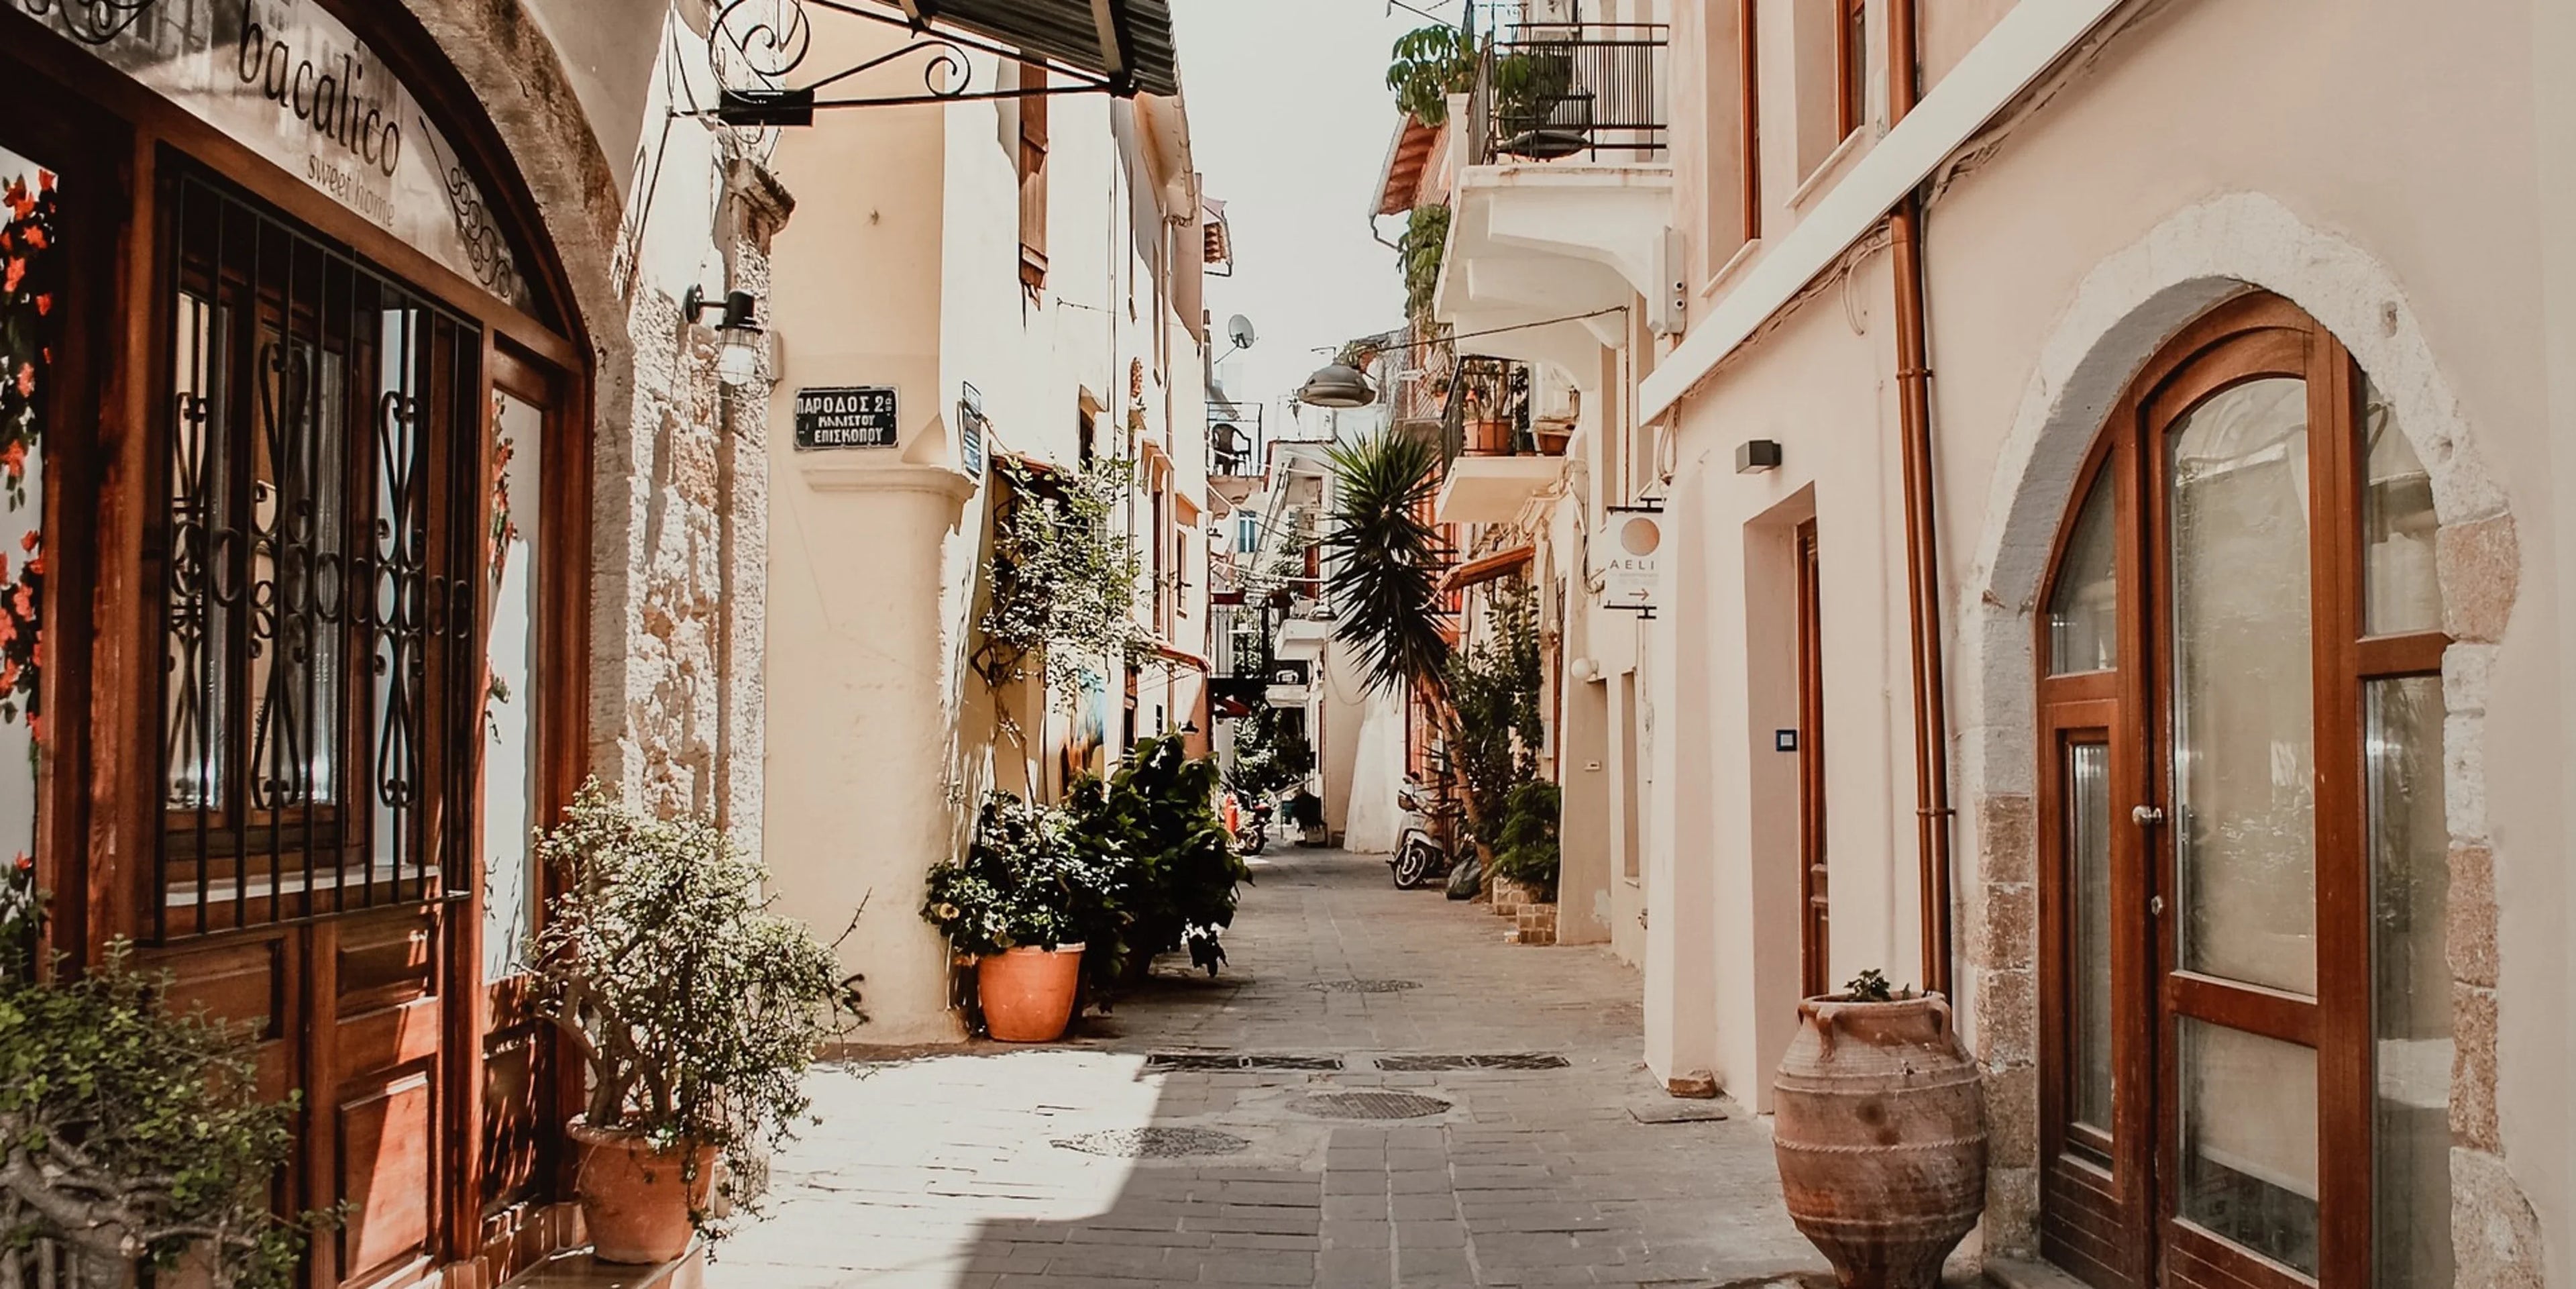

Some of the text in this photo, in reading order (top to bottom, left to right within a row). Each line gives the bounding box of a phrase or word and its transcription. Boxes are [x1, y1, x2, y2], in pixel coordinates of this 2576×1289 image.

[239, 0, 400, 177] bacalico
[308, 154, 394, 227] sweet home
[796, 396, 869, 414] ΠΑΡΟΔΟΣ
[814, 427, 883, 443] ΕΠΙΣΚΟΠΟΥ
[1609, 559, 1654, 570] AELI
